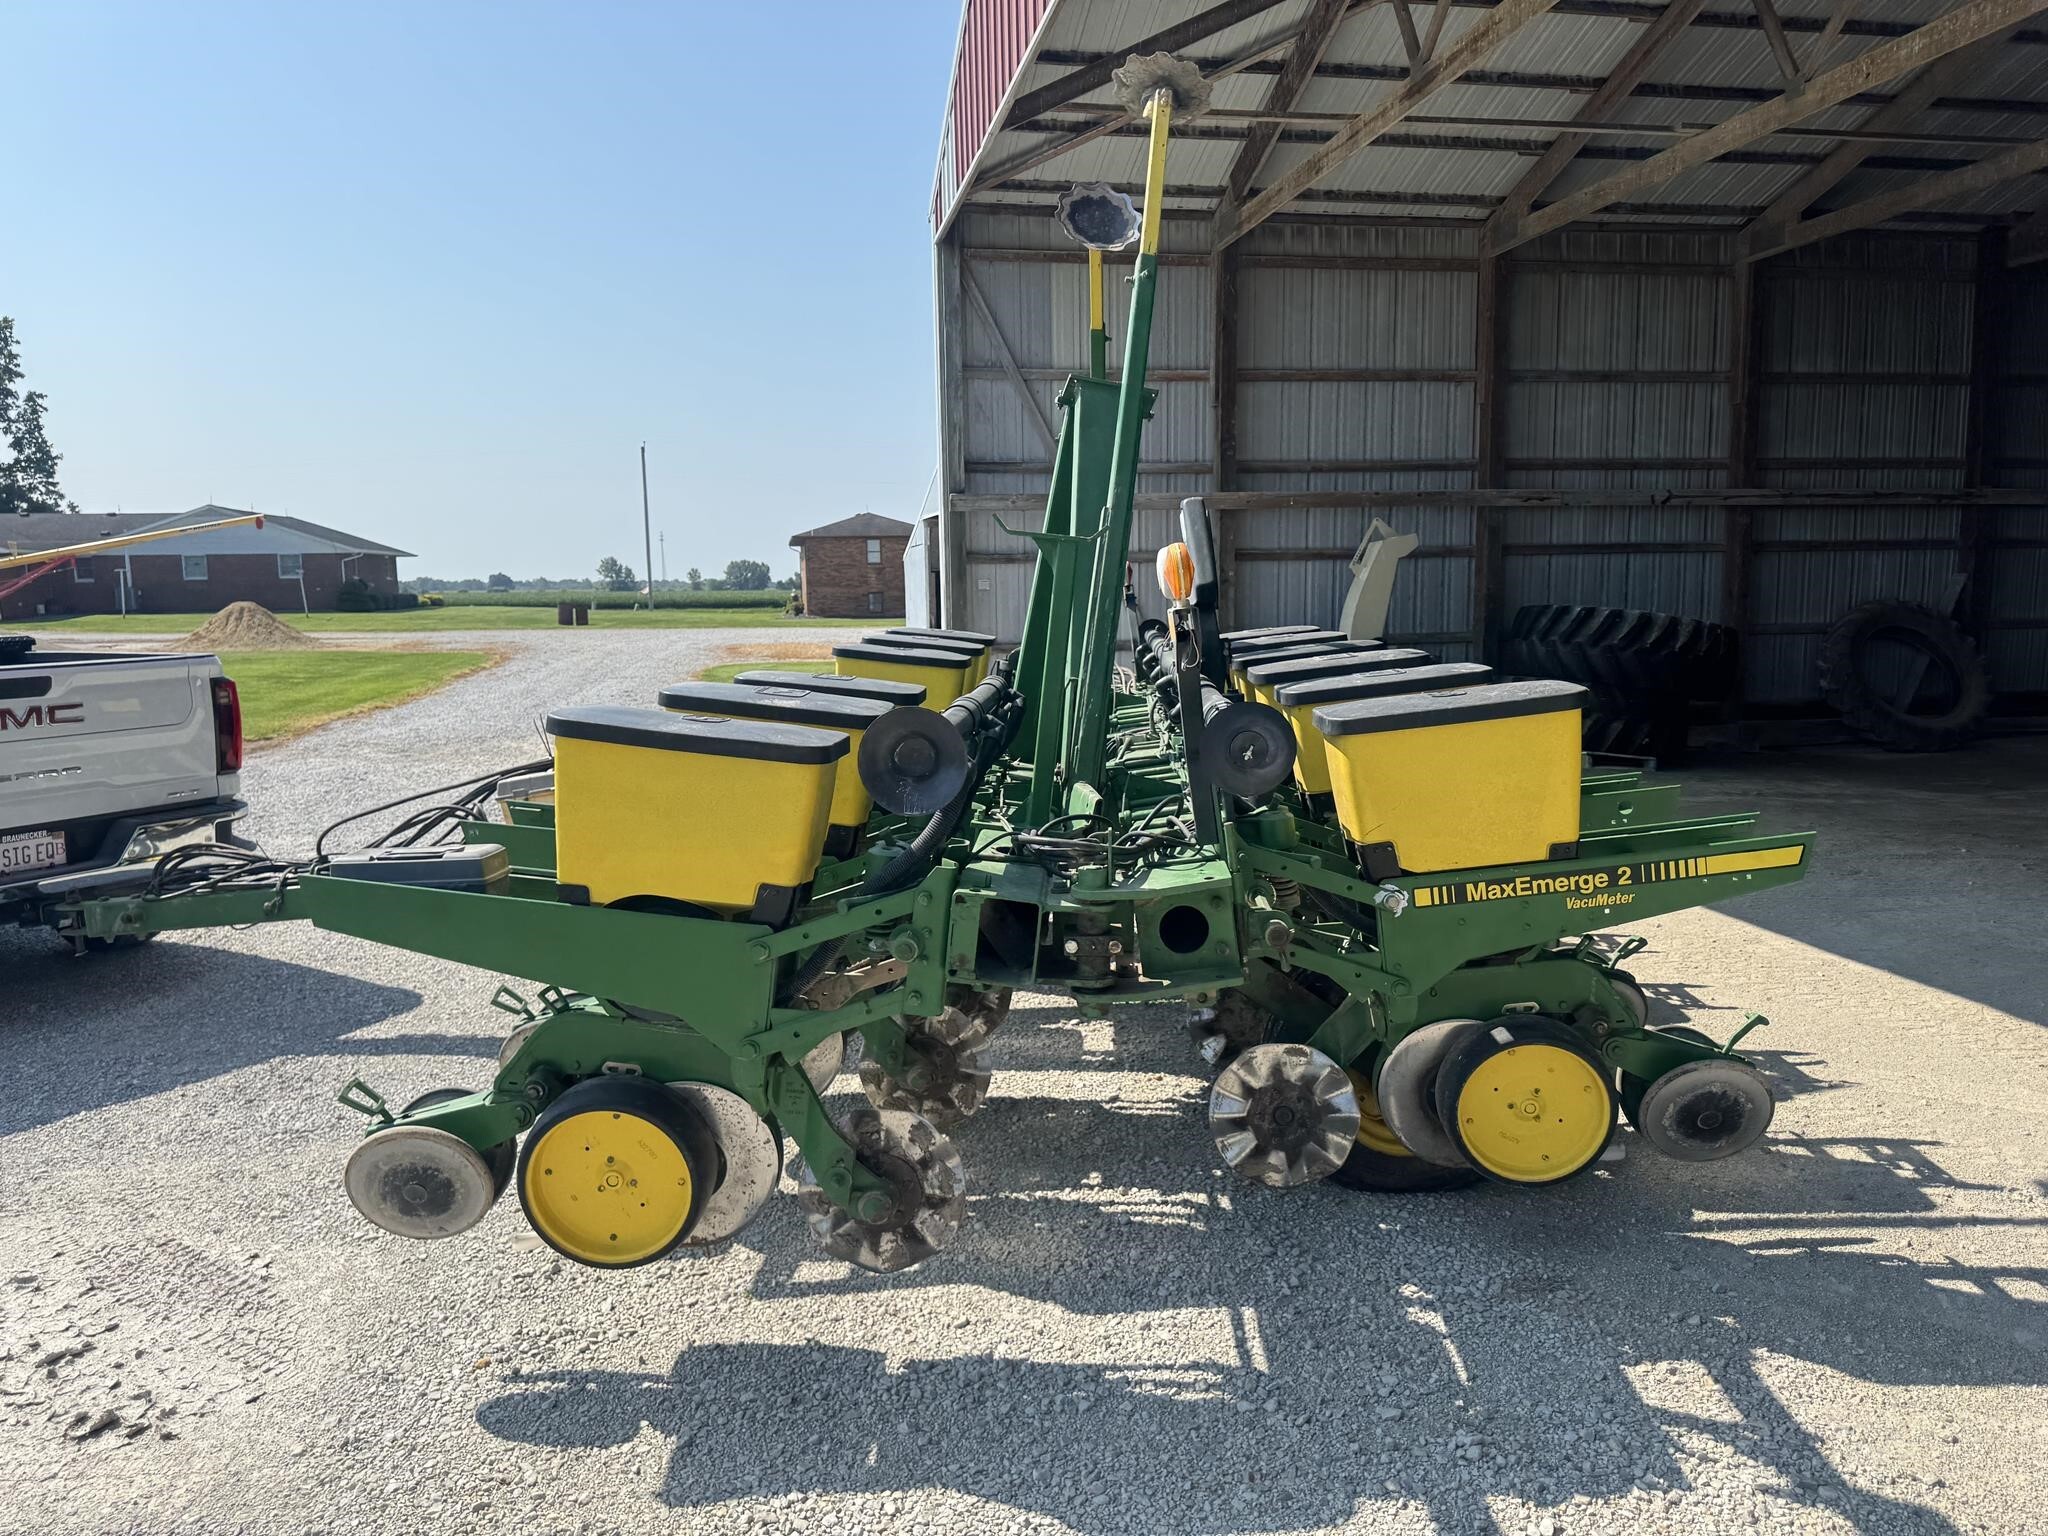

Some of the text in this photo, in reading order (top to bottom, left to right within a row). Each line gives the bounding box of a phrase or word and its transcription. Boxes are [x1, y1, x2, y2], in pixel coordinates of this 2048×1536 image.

[3, 845, 31, 868] SIG
[1466, 866, 1632, 902] MaxEmerge 2
[1566, 892, 1636, 910] VacuMeter
